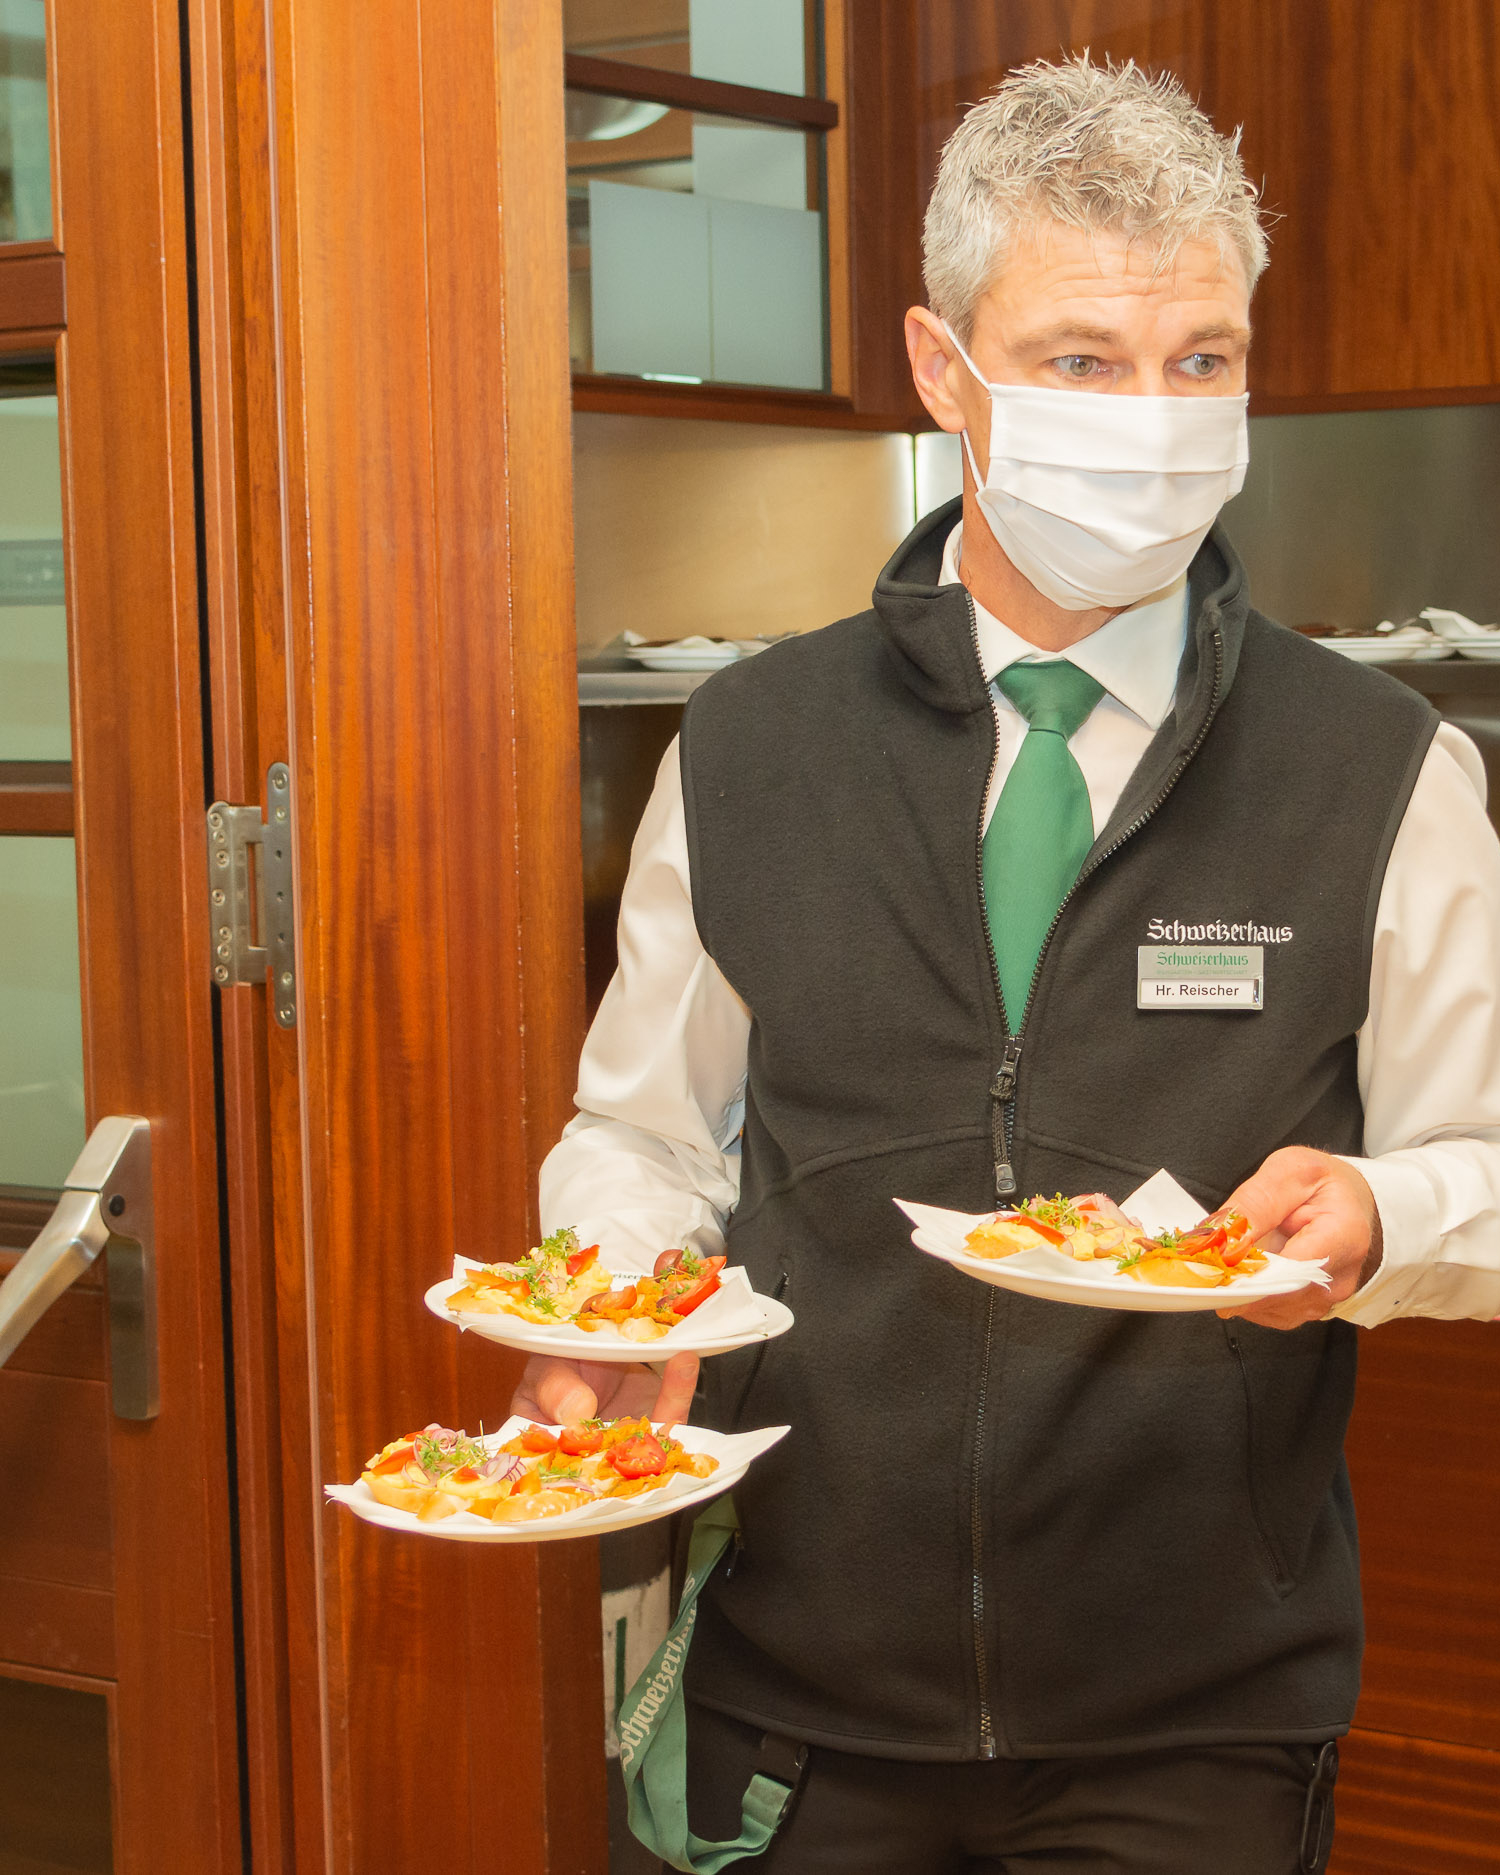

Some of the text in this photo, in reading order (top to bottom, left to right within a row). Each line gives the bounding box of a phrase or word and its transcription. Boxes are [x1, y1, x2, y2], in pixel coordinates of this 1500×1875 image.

[1146, 918, 1294, 944] Schweizerhaus
[1156, 952, 1249, 967] Schweizerhaus
[1156, 984, 1240, 996] Hr. Reischer
